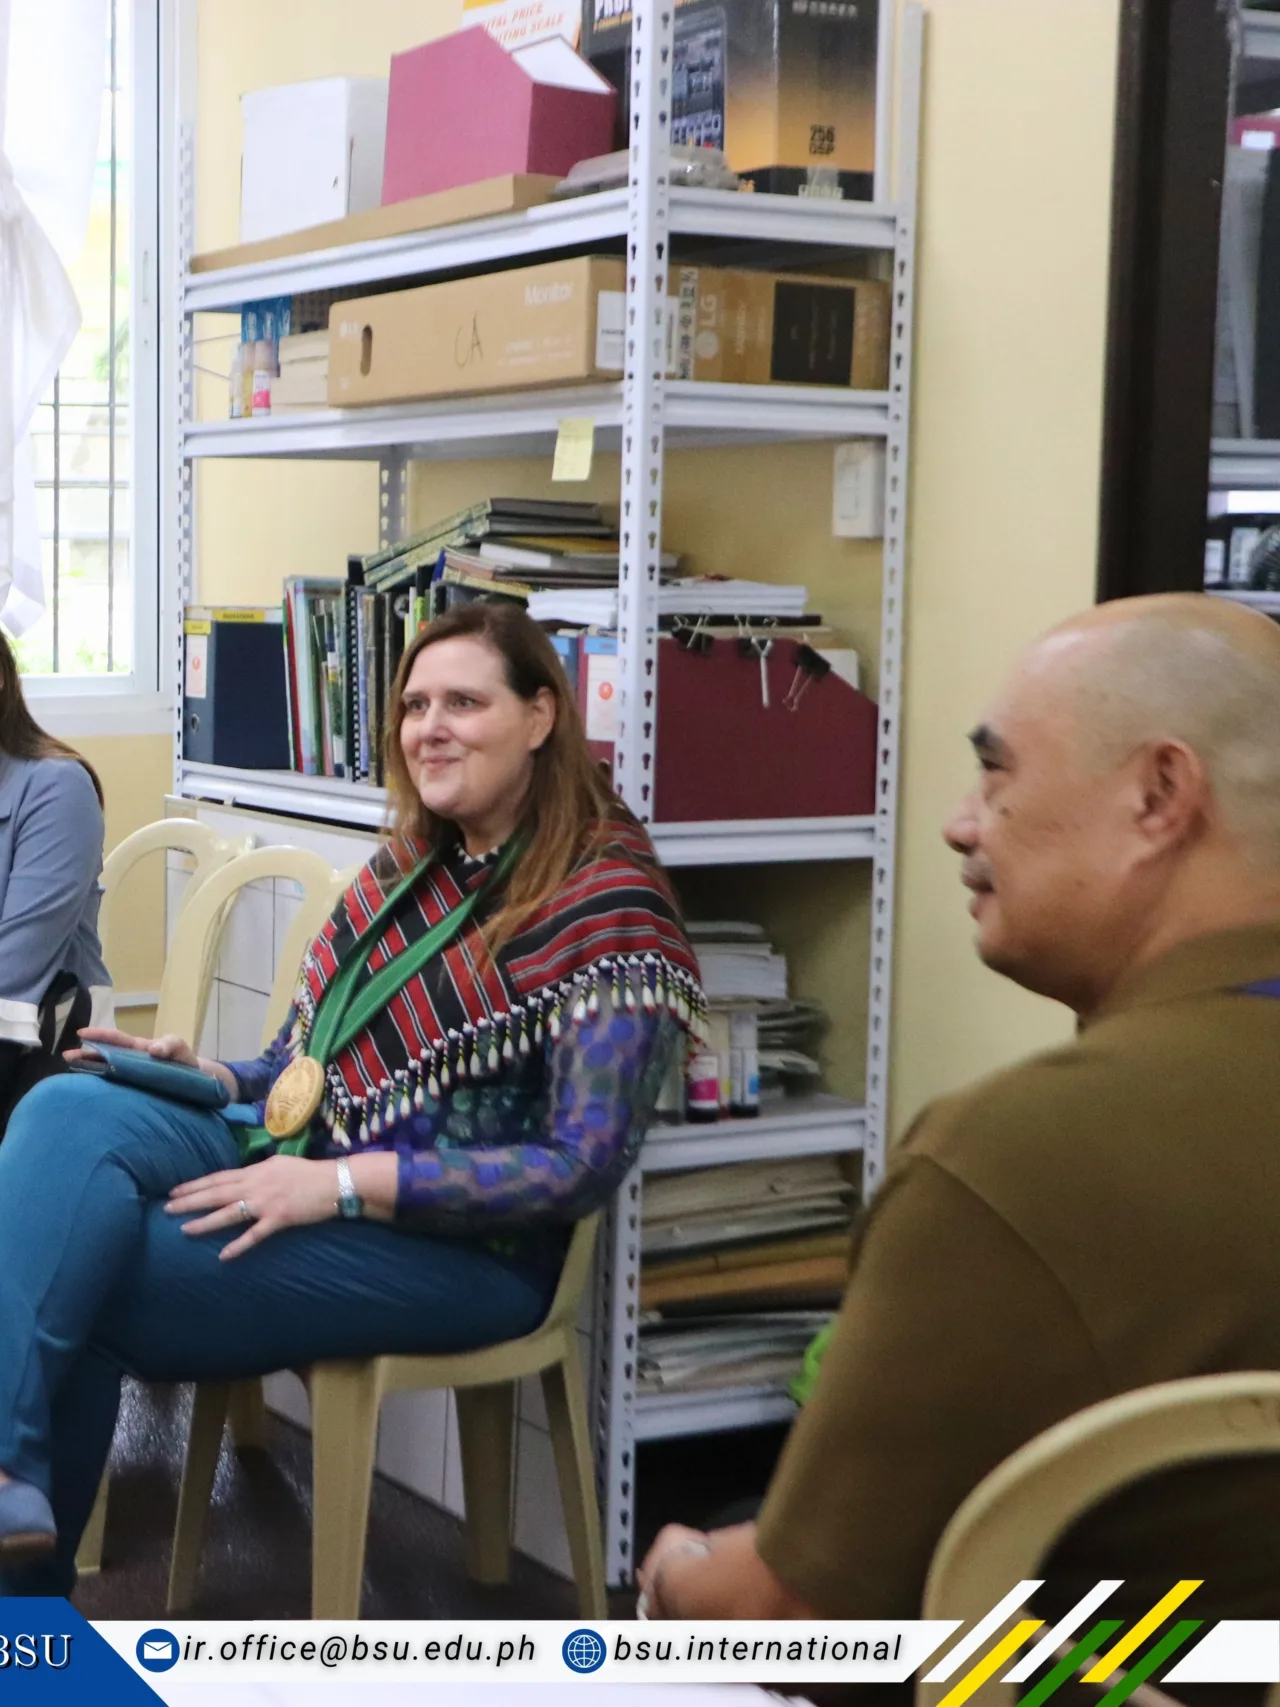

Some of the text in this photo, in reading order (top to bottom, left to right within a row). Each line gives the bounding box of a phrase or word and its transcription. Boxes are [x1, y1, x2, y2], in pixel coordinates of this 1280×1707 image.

[512, 2, 543, 23] PRICE
[531, 12, 566, 33] SCALE
[525, 282, 573, 306] Monitor
[700, 294, 717, 326] LG
